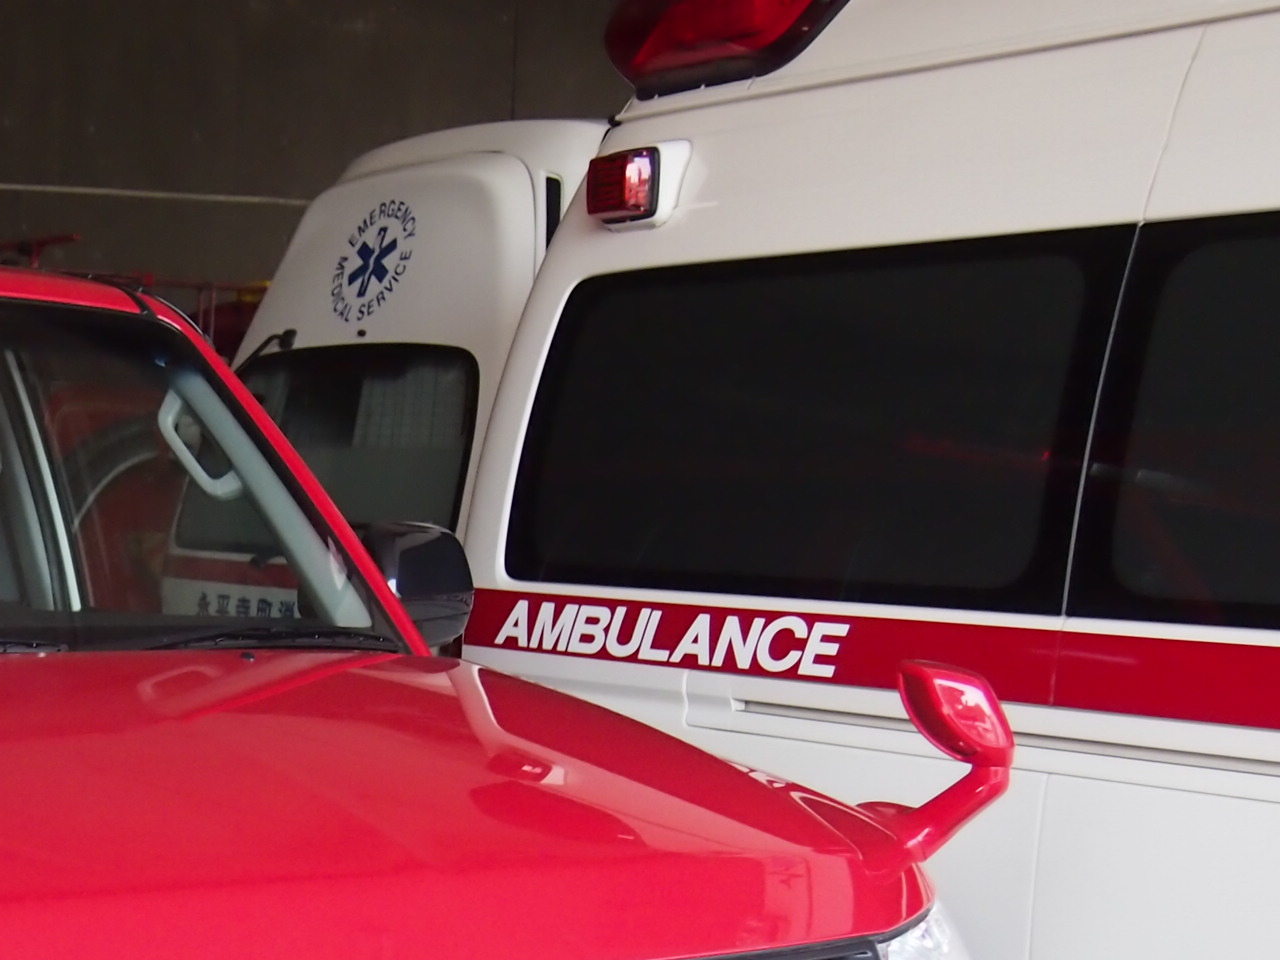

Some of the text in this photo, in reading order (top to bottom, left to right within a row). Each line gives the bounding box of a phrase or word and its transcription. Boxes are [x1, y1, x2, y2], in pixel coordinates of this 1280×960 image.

[348, 199, 416, 248] EMERGENCY
[331, 249, 413, 323] MEDICAL SERVICE
[494, 599, 851, 678] AMBULANCE
